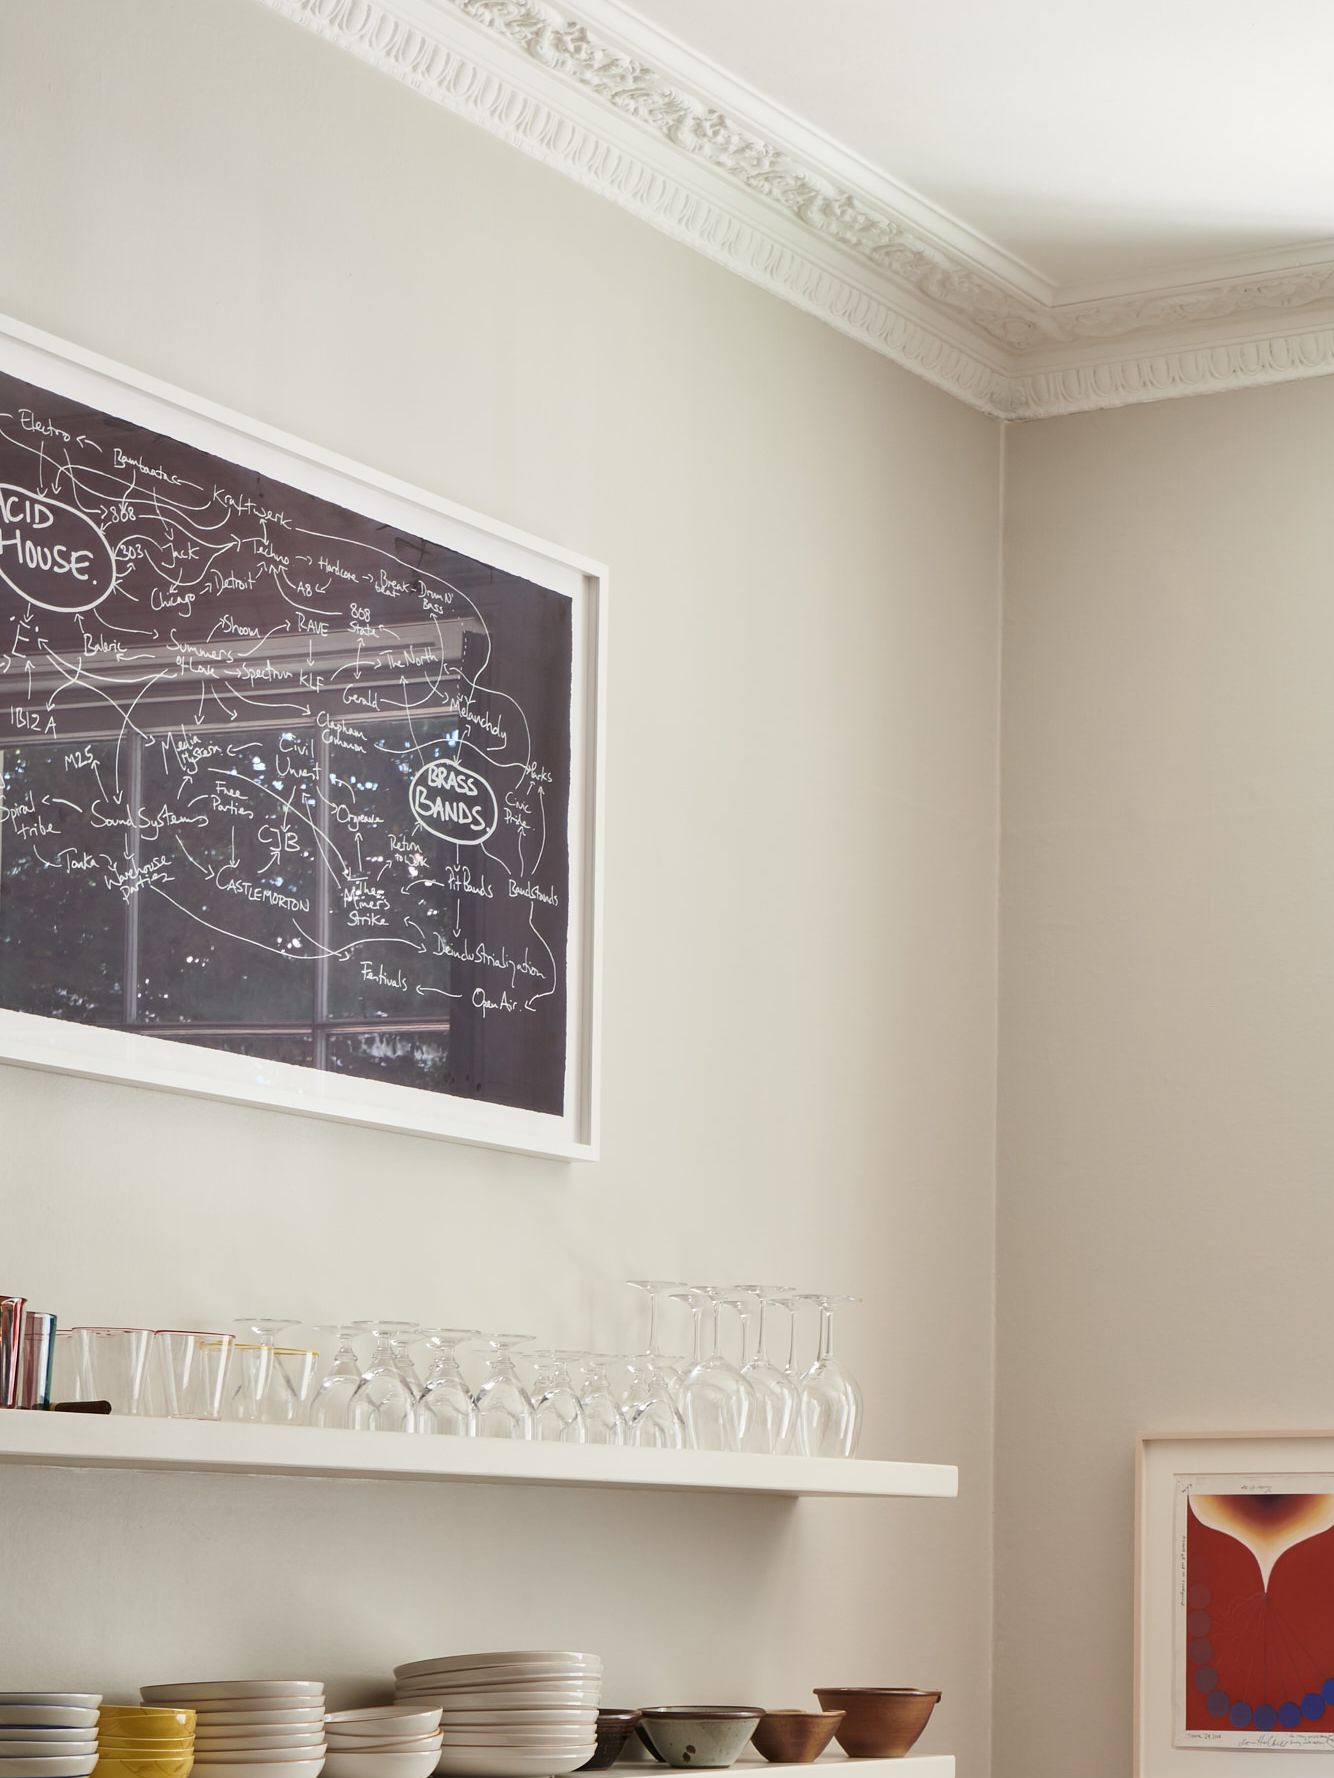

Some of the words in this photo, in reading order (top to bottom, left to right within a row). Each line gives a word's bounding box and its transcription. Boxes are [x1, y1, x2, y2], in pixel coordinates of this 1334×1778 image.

[18, 409, 71, 442] Electro
[109, 506, 137, 523] 808
[213, 484, 293, 530] Kraftwerk
[118, 544, 144, 560] 303
[253, 540, 290, 565] Techno
[210, 569, 256, 596] Detroit
[318, 556, 359, 582] Hardcore
[151, 588, 196, 618] Chicago
[350, 602, 371, 622] 808
[223, 614, 261, 638] Shoom
[295, 611, 330, 637] RAVE
[347, 620, 380, 638] State
[379, 650, 405, 670] The
[403, 645, 438, 667] North
[299, 668, 325, 693] KLF
[342, 683, 380, 712] Gerald
[64, 744, 95, 772] M25
[279, 731, 315, 758] Civil
[215, 780, 249, 800] Free
[427, 765, 479, 796] BRASS
[90, 799, 137, 829] Sound
[137, 803, 209, 841] Systems
[210, 794, 254, 819] Parties
[16, 815, 62, 840] tribe
[104, 855, 173, 890] Warehouse
[462, 866, 494, 899] Bands
[215, 864, 311, 913] CASTLEMORTON
[508, 878, 560, 907] Bandstands
[346, 910, 390, 927] Strike
[360, 961, 408, 992] Festivals
[471, 987, 499, 1019] Open
